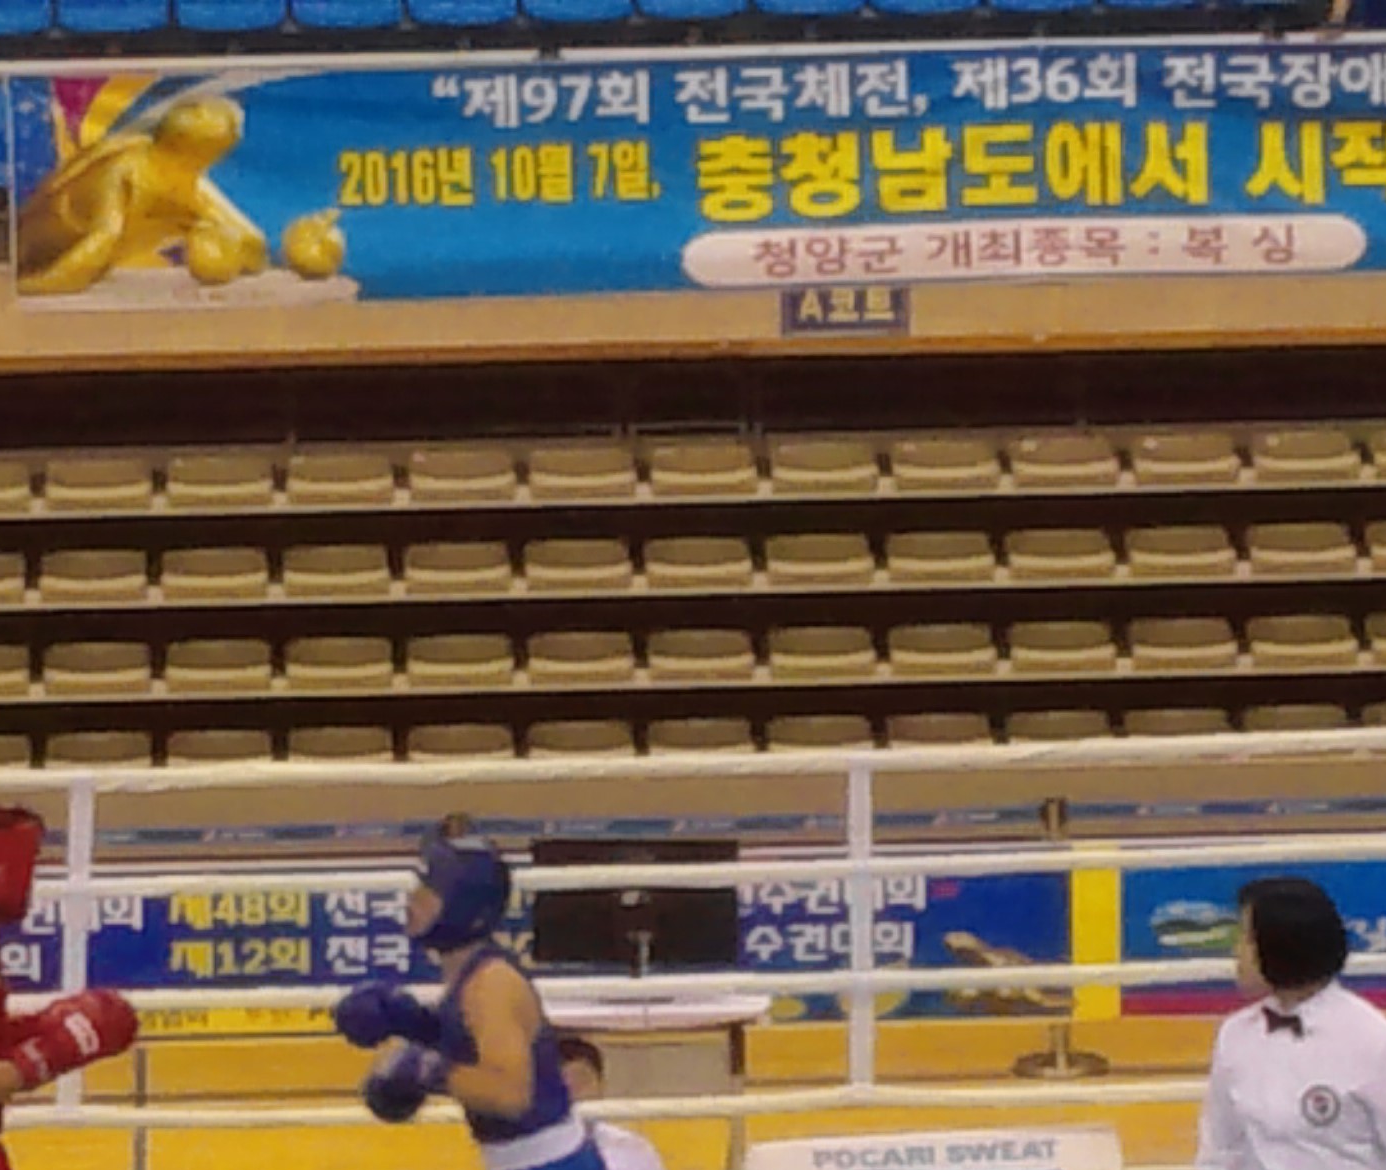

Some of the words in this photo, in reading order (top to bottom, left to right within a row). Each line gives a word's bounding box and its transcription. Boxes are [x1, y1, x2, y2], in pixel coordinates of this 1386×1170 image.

[674, 57, 928, 124] 전국체전,
[952, 52, 1138, 110] 제36회
[337, 146, 475, 206] 2016년
[490, 142, 573, 205] 10월
[696, 119, 1209, 222] 충청남도에서
[754, 234, 903, 278] 청양군
[926, 225, 1126, 269] 개최종목
[798, 287, 895, 324] A코트
[169, 892, 310, 931] 제48회
[326, 891, 408, 928] 전국
[170, 937, 311, 978] 제12회
[326, 935, 410, 975] 전국
[812, 1144, 935, 1170] POCARI
[942, 1138, 1058, 1164] SWEAT
